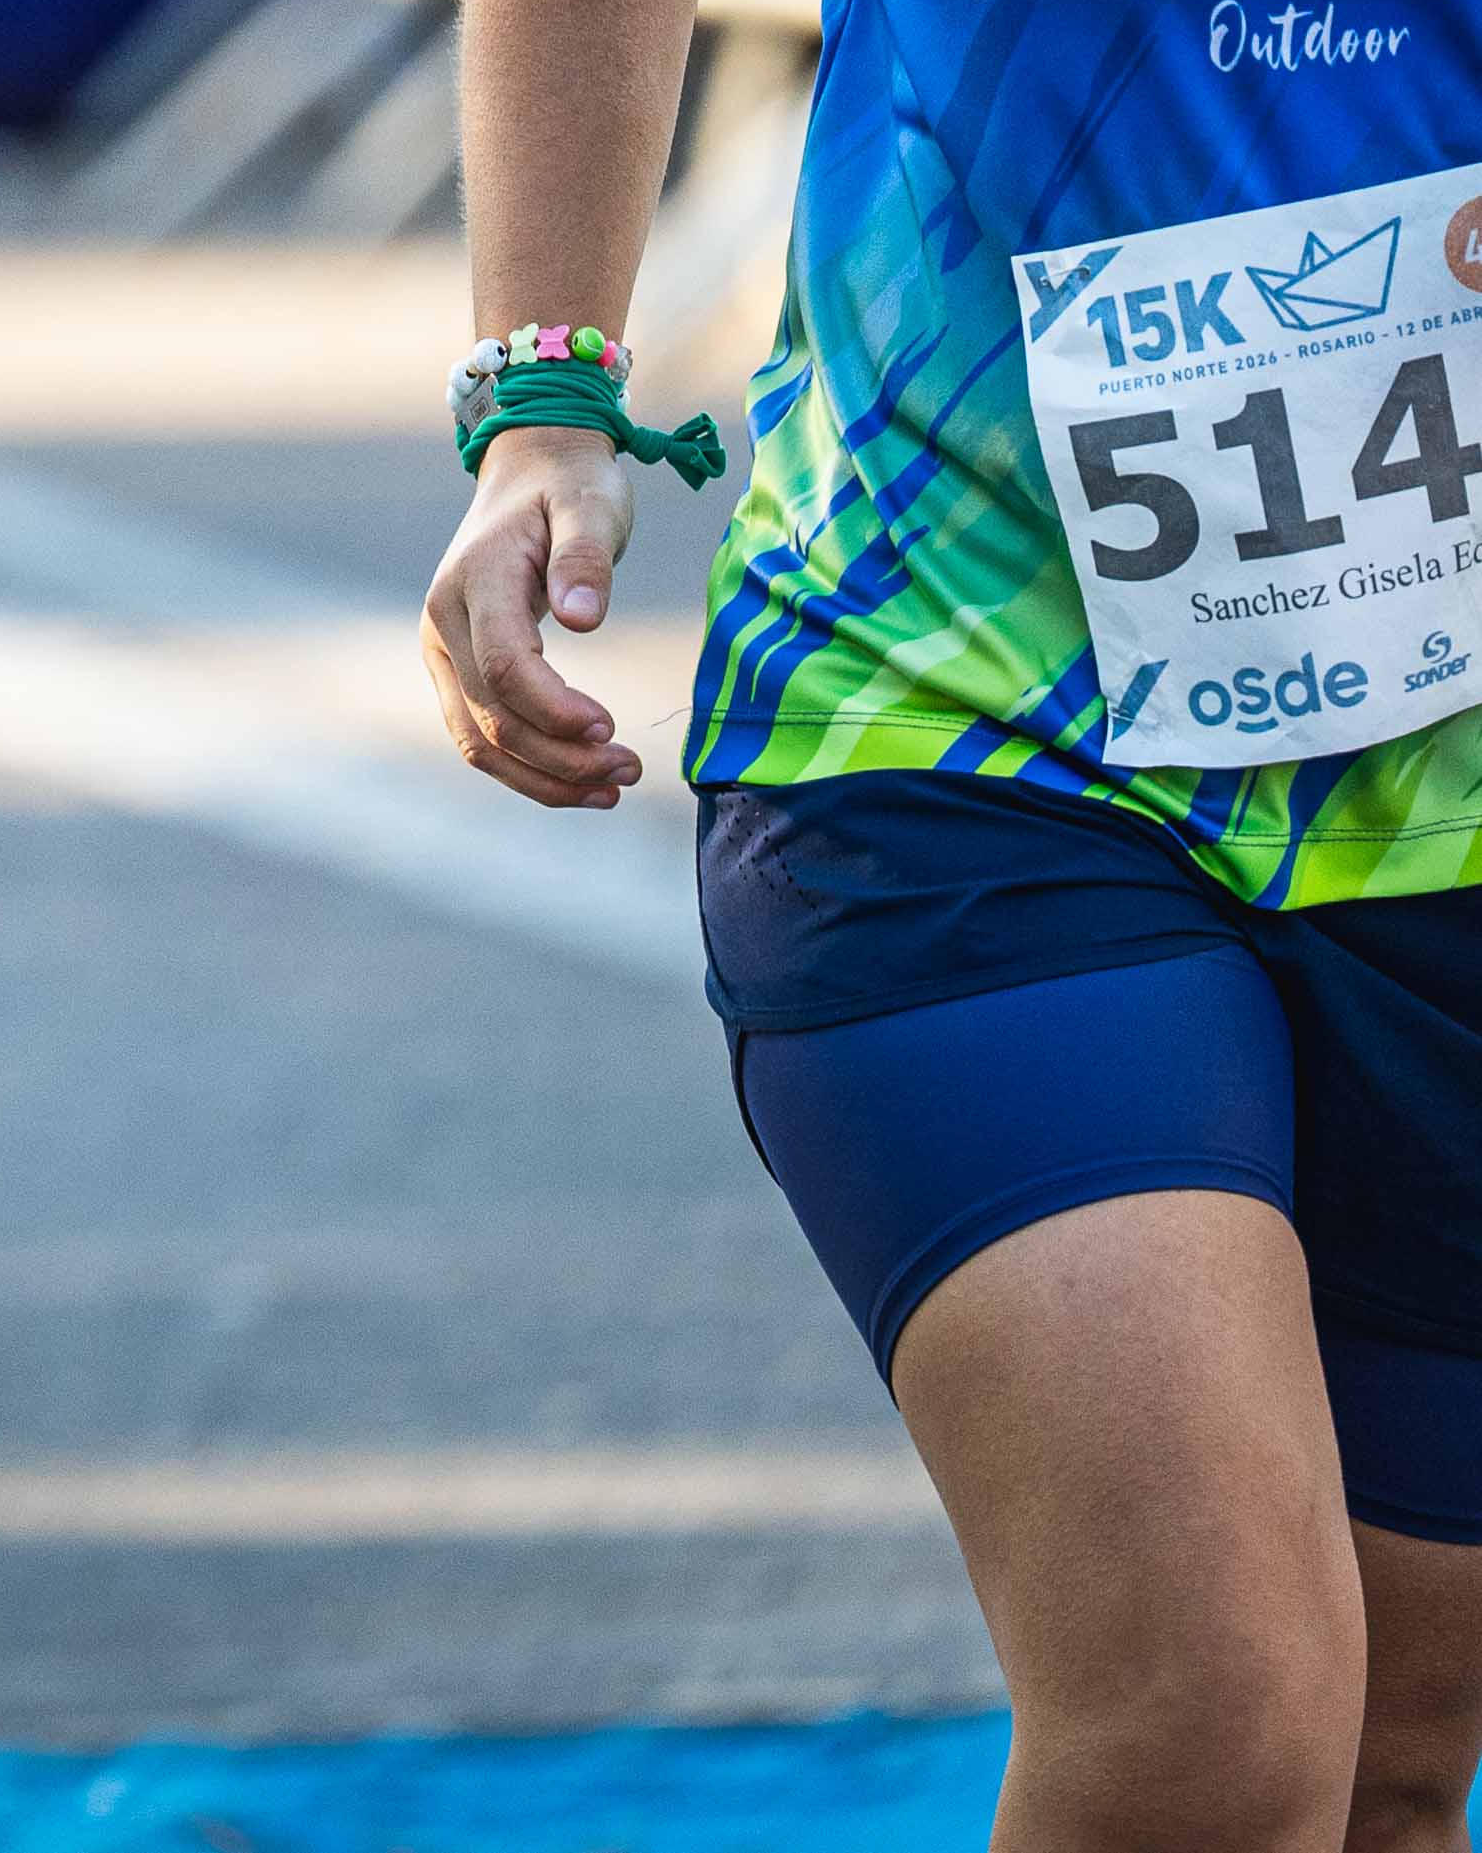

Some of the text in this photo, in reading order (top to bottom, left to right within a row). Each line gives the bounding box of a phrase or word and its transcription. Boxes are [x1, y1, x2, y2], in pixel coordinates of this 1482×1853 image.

[1086, 271, 1247, 368] 15K
[1098, 373, 1166, 396] PUERTO
[1172, 360, 1228, 383] NORTE
[1234, 350, 1277, 371] 2026
[1298, 331, 1375, 359] ROSARIO
[1396, 322, 1416, 337] 12
[1422, 315, 1443, 332] DE
[1190, 583, 1330, 624] Sanchez
[1338, 552, 1444, 600] Gisela
[1188, 651, 1369, 734] osde
